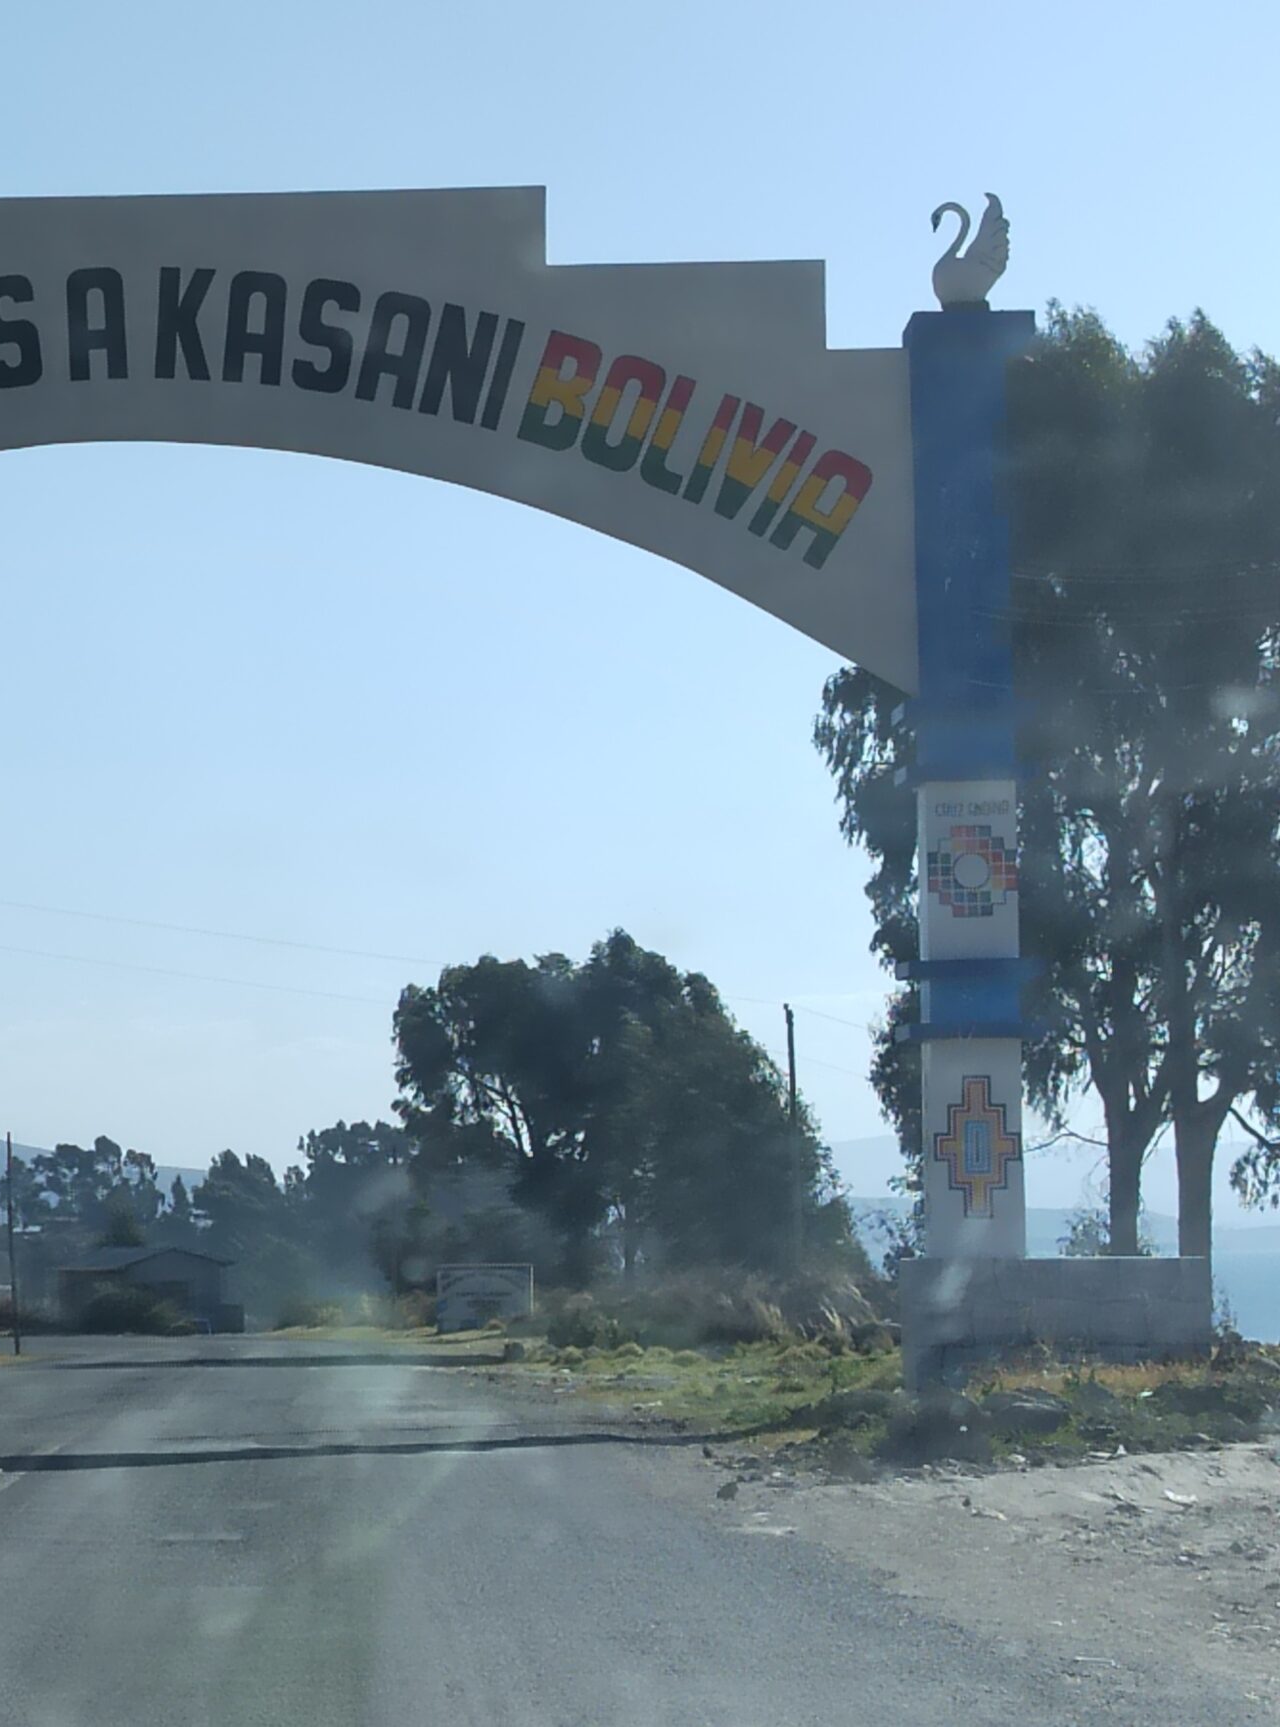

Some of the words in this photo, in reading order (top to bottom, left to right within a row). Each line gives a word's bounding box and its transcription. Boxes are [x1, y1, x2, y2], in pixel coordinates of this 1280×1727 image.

[66, 267, 128, 382] A
[154, 267, 525, 430] KASANI
[517, 330, 873, 570] BOLIVIA
